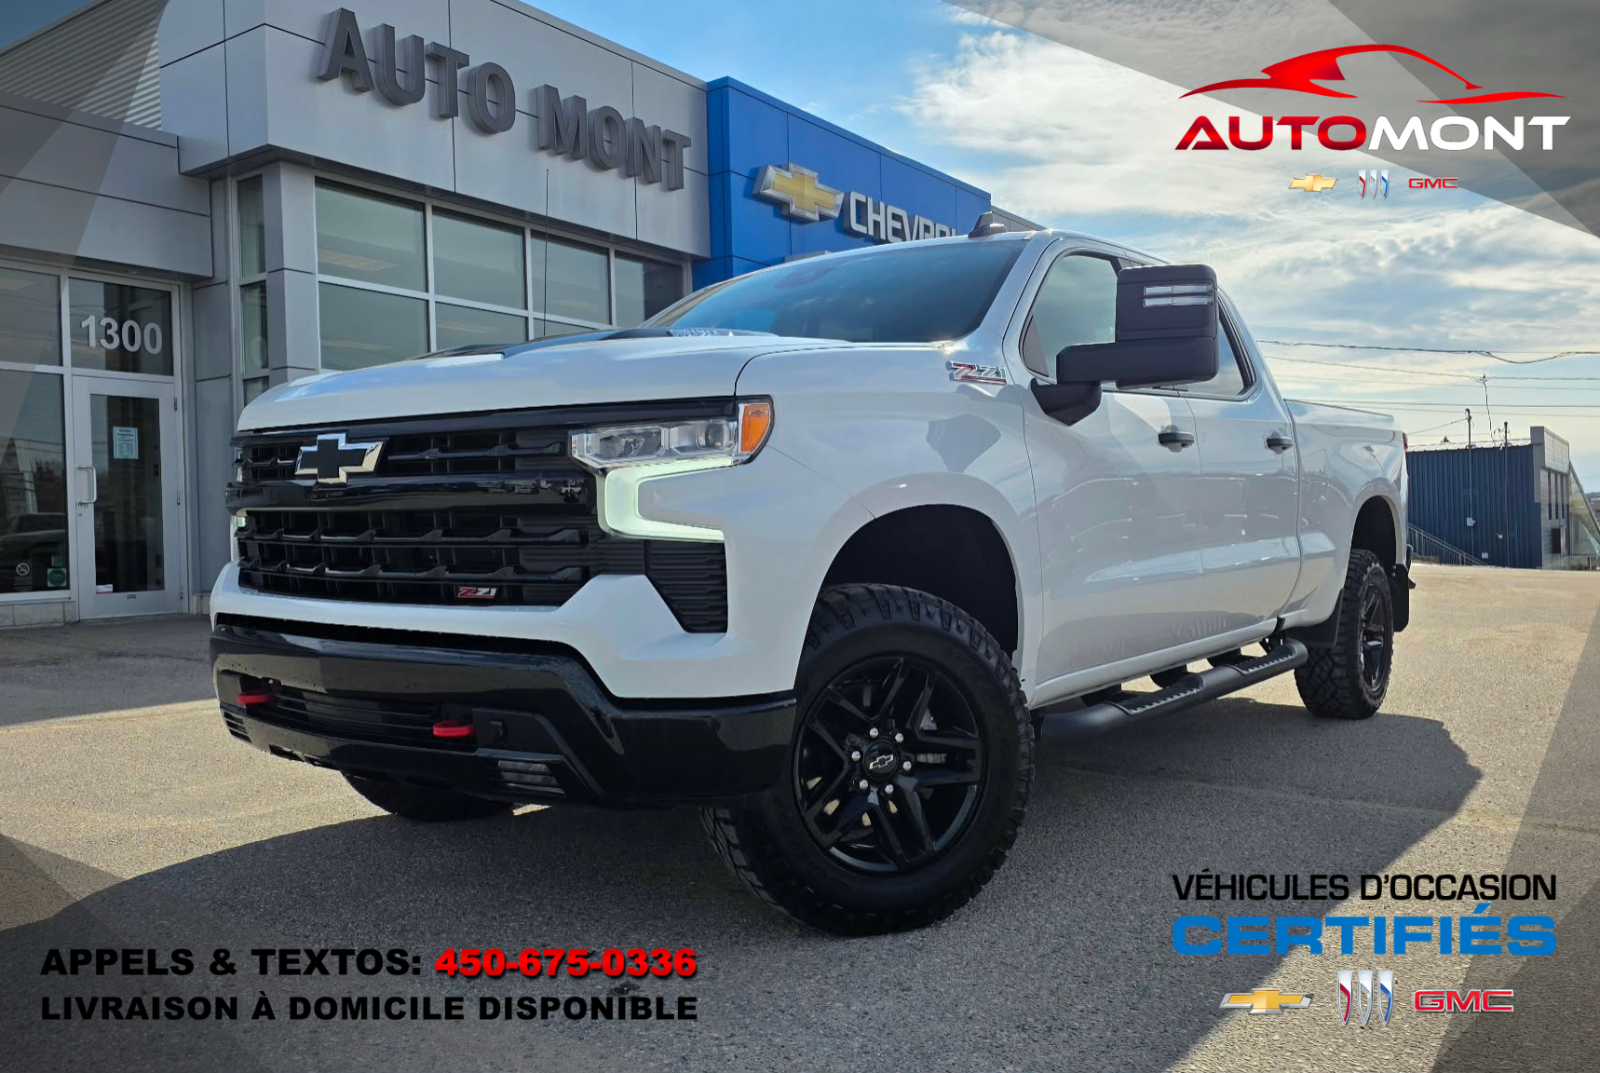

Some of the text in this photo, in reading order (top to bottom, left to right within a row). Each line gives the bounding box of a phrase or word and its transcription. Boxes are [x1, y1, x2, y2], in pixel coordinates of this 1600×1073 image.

[317, 7, 692, 191] AUTO MONT
[81, 314, 163, 355] 1300
